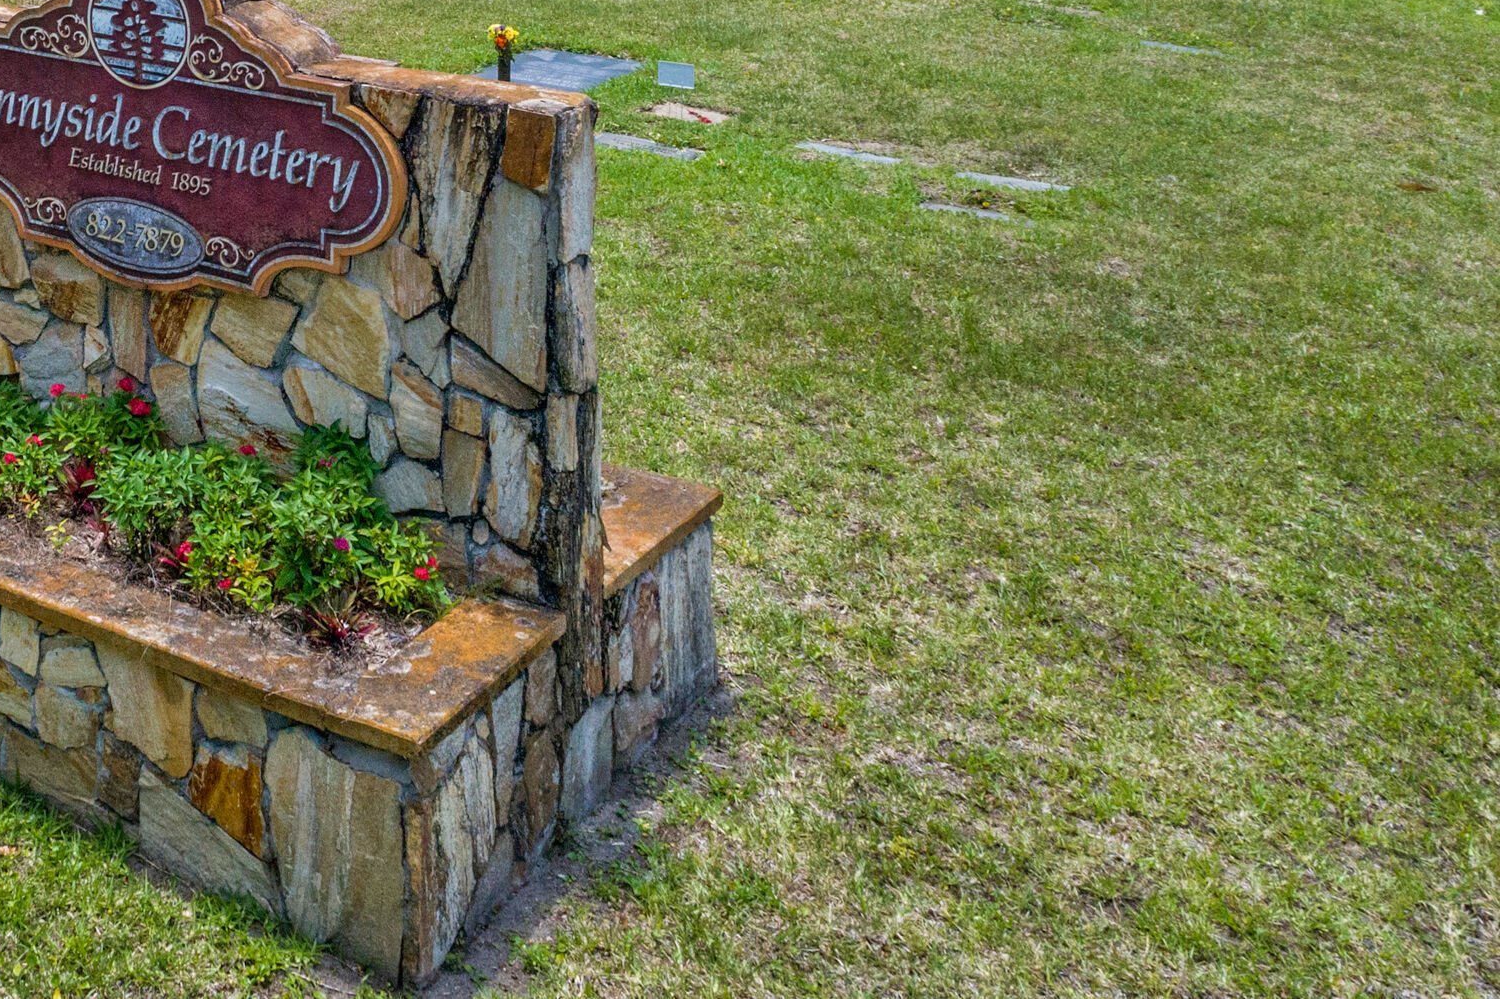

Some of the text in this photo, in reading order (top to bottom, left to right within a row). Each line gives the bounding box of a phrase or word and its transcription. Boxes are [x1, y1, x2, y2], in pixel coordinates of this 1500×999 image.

[68, 147, 211, 196] Established 1895
[152, 105, 360, 212] Cemetery
[85, 211, 185, 257] 822-7879
